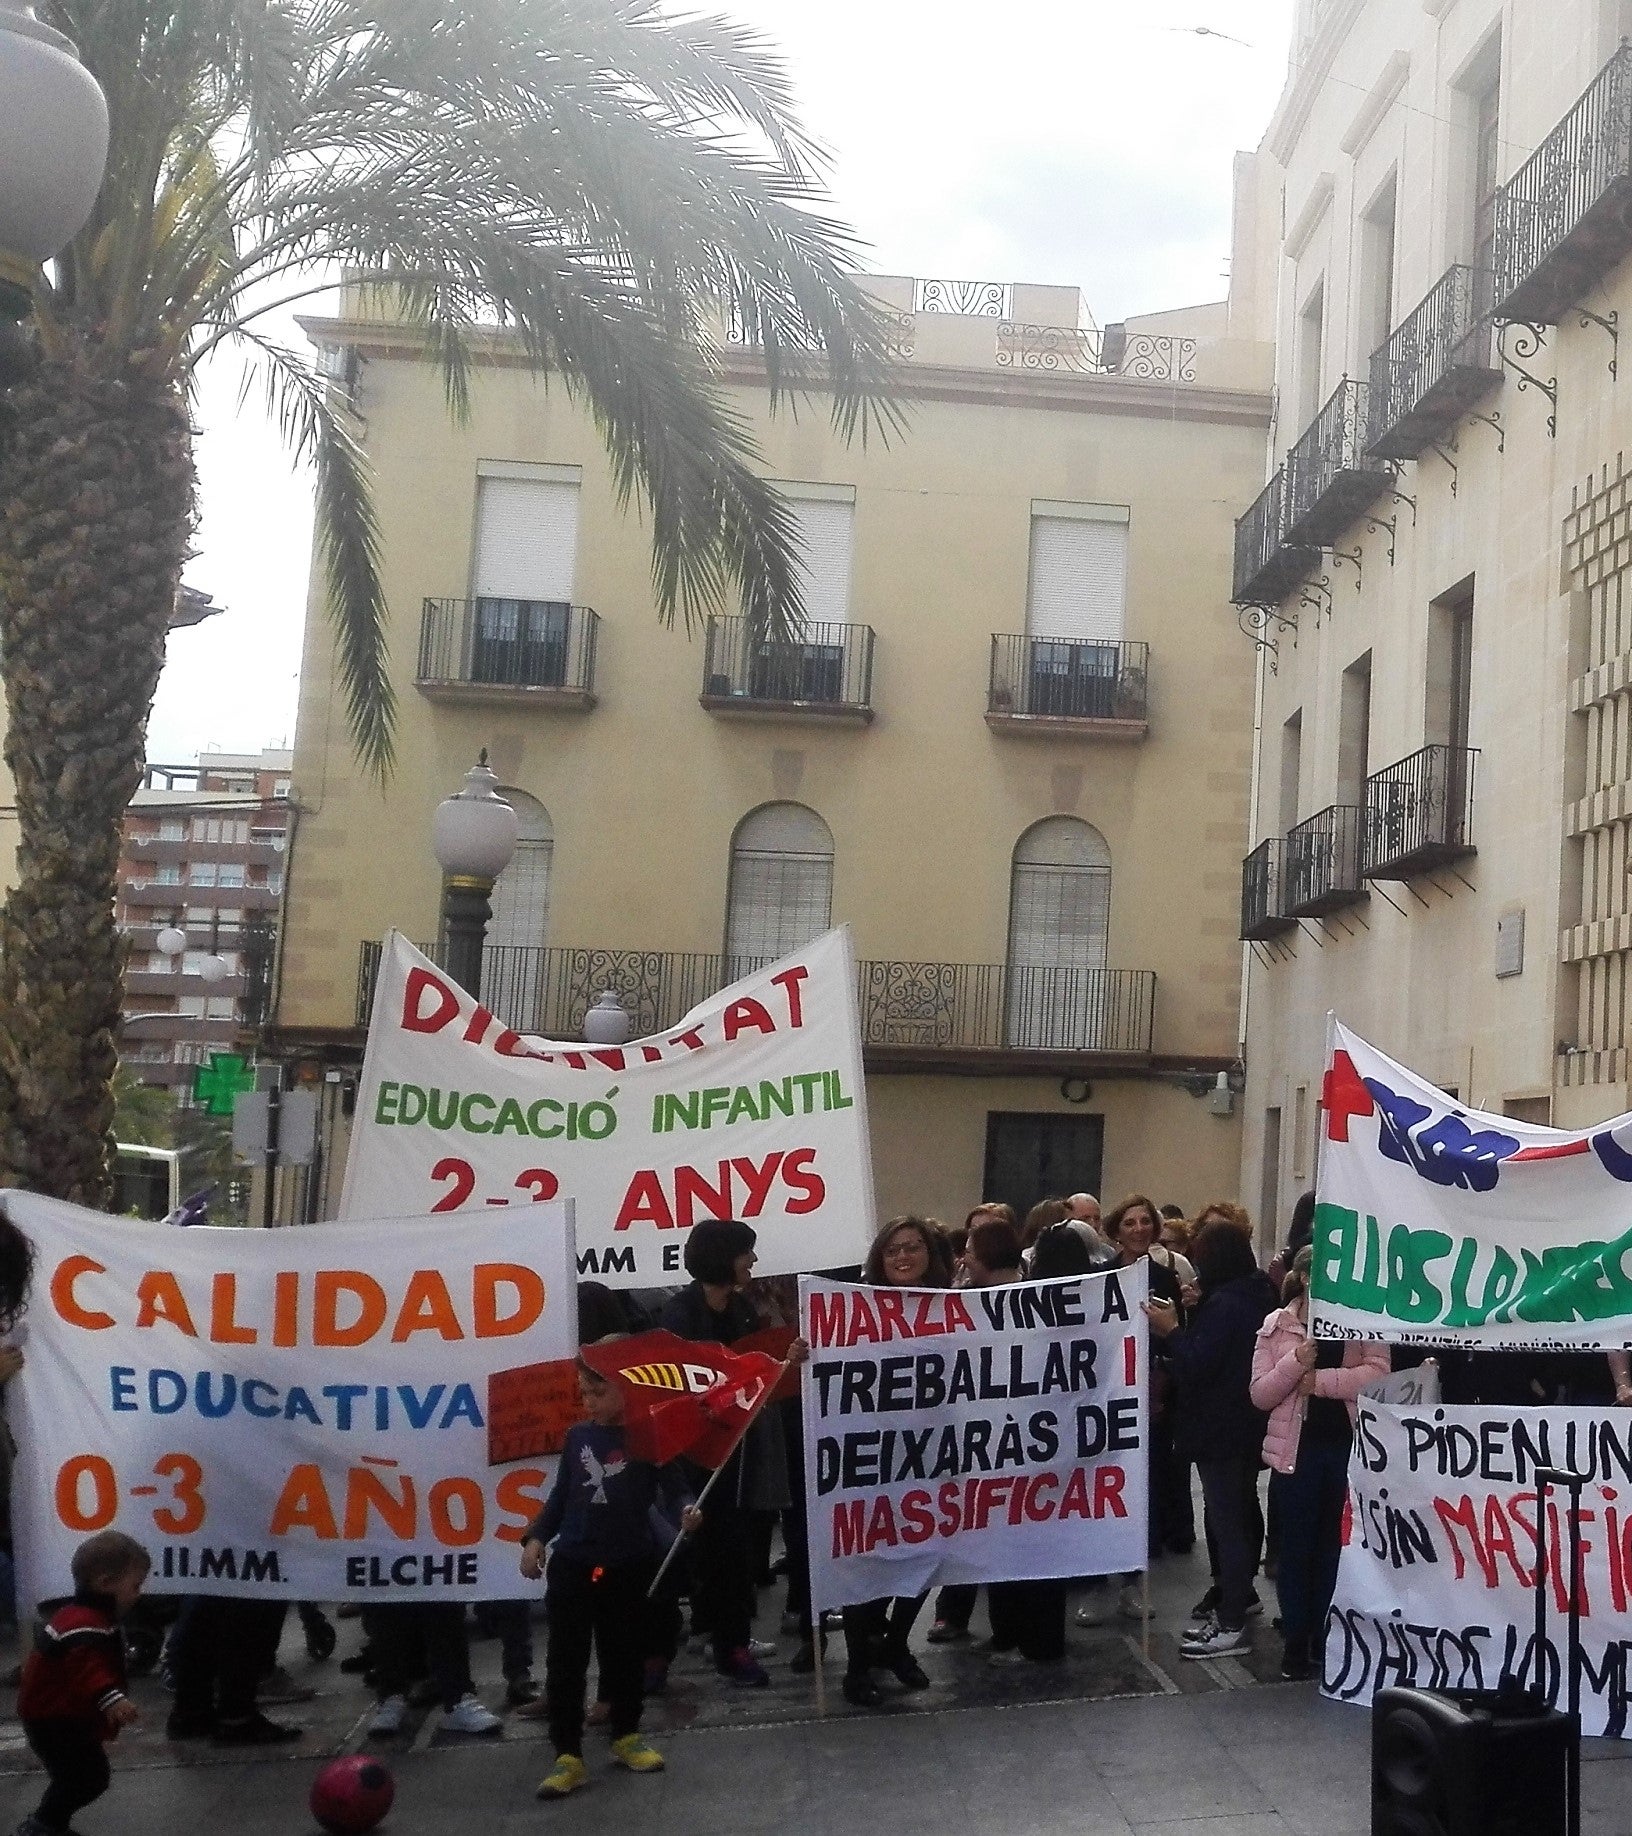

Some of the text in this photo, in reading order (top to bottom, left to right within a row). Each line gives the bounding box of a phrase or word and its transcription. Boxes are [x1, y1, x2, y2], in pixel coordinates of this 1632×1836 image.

[373, 1068, 854, 1142] EDUCACIÓ INFANTIL
[613, 1147, 826, 1232] ANYS
[49, 1253, 546, 1348] CALIDAD
[979, 1280, 1086, 1332] VINE
[1100, 1272, 1129, 1324] A
[1309, 1202, 1453, 1324] ELLOS
[109, 1365, 485, 1432] EDUCATIVA
[812, 1337, 1098, 1419] TREBALLAR
[1123, 1335, 1137, 1387] I
[816, 1397, 1141, 1497] DEIXARÀS DE
[54, 1452, 547, 1547] 0-3 AÑOS
[831, 1465, 1129, 1560] MASSIFICAR
[346, 1552, 478, 1587] ELCHE
